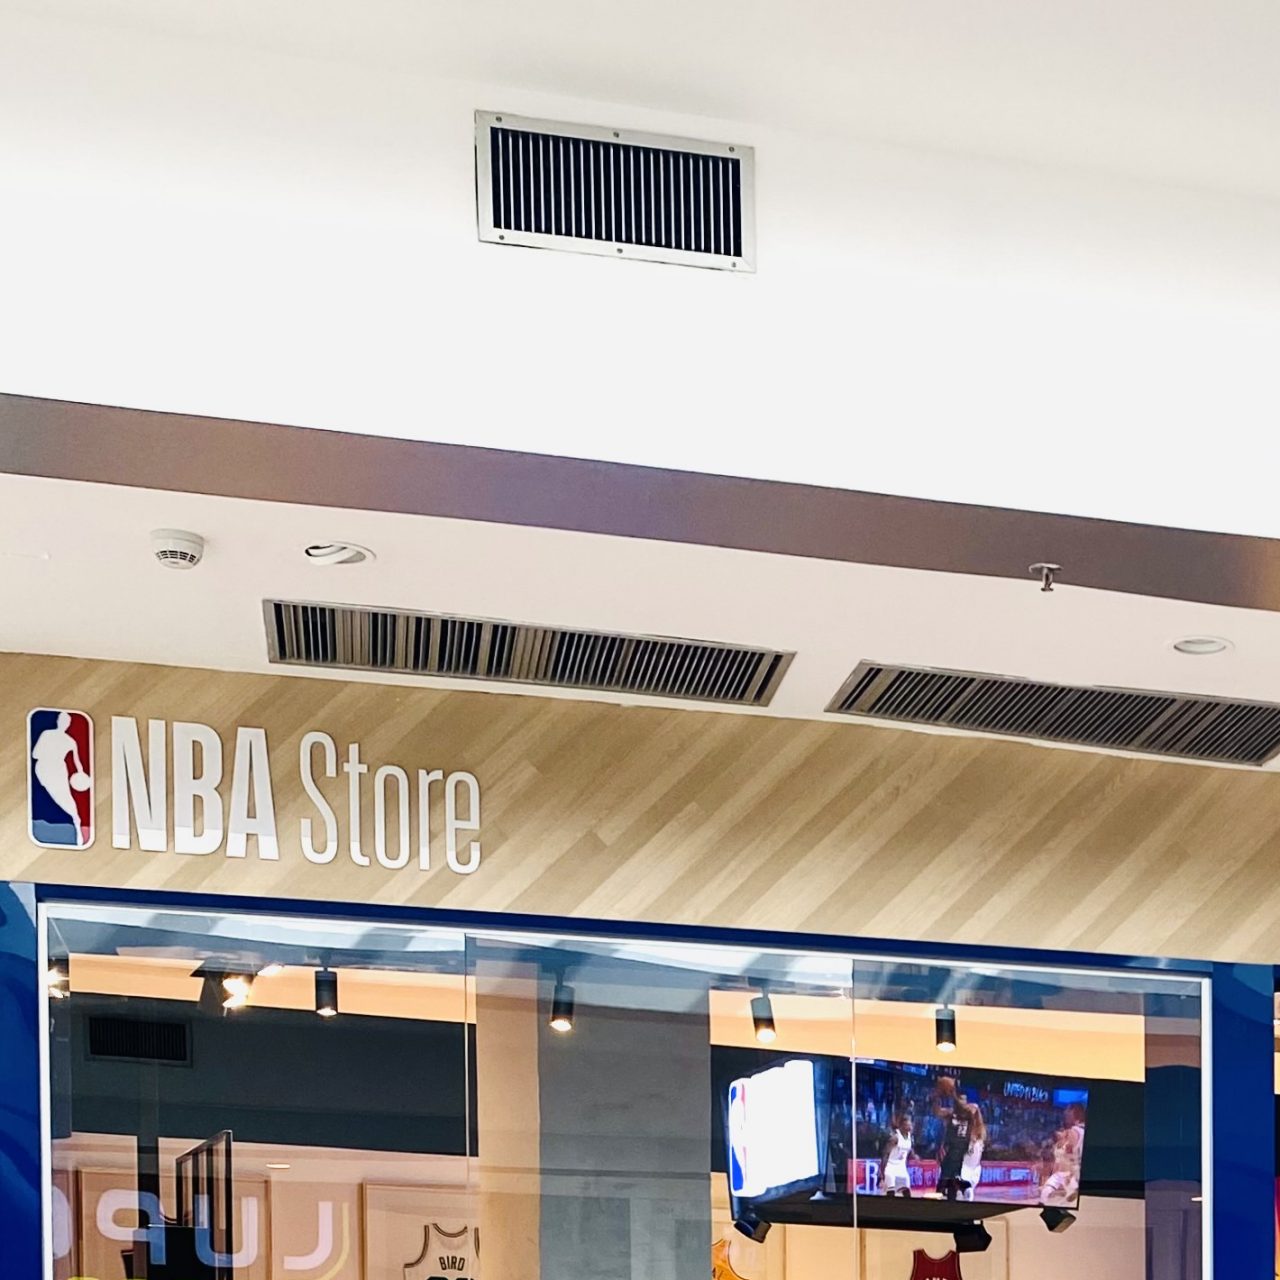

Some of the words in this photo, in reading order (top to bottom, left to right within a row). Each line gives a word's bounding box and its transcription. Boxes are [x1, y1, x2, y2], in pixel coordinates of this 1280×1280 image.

[111, 715, 280, 860] NBA
[300, 731, 482, 875] Store
[438, 1256, 465, 1272] BIRD
